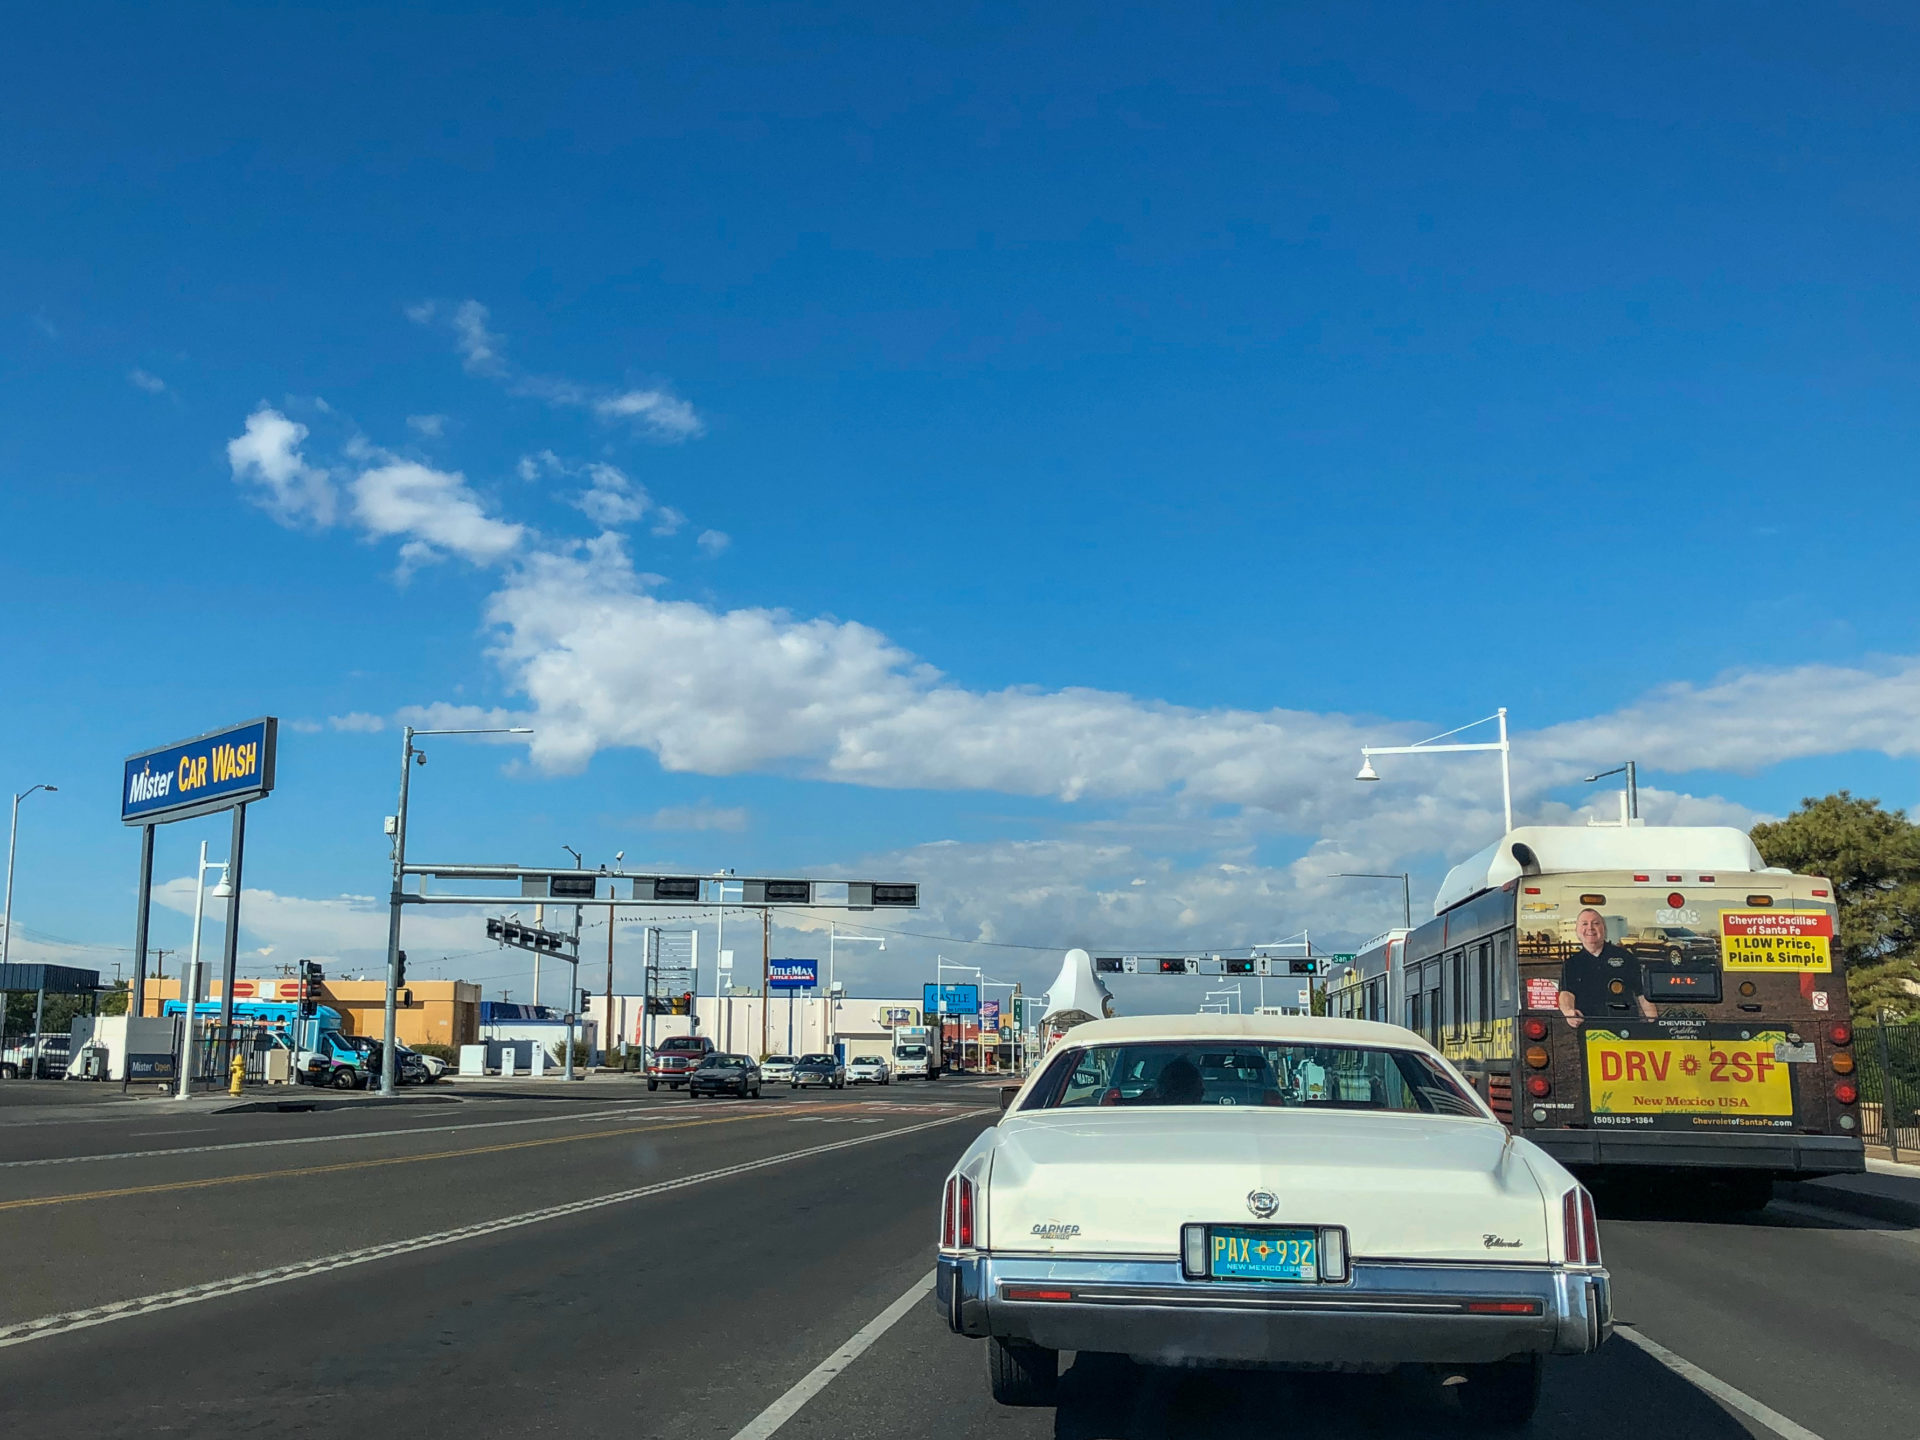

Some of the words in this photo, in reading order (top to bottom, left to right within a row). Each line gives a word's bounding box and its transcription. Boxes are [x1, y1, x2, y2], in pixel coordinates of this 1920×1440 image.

[129, 769, 174, 804] Mister
[178, 755, 208, 792] CAR
[211, 741, 257, 783] WASH
[1657, 909, 1698, 923] 6408
[1728, 915, 1776, 925] Chevrolet
[1778, 916, 1818, 925] Cadillac
[1746, 926, 1757, 934] of
[1759, 926, 1788, 934] Santa
[1790, 926, 1801, 935] Fe
[1734, 938, 1740, 948] 1
[1744, 938, 1772, 948] LOW
[1776, 938, 1816, 951] Price,
[1729, 952, 1763, 962] Plain
[1766, 952, 1775, 962] &
[1778, 952, 1824, 966] Simple
[132, 1061, 152, 1072] Mister
[1600, 1051, 1672, 1082] DRV
[1709, 1051, 1776, 1083] 2SF
[1633, 1096, 1663, 1106] New
[1665, 1096, 1715, 1107] Mexico
[1718, 1097, 1750, 1108] USA
[1032, 1224, 1079, 1233] GARNER
[1214, 1236, 1250, 1263] PAX
[1276, 1240, 1313, 1266] 932
[1227, 1263, 1247, 1271] NEW
[1249, 1264, 1281, 1272] MEXICO
